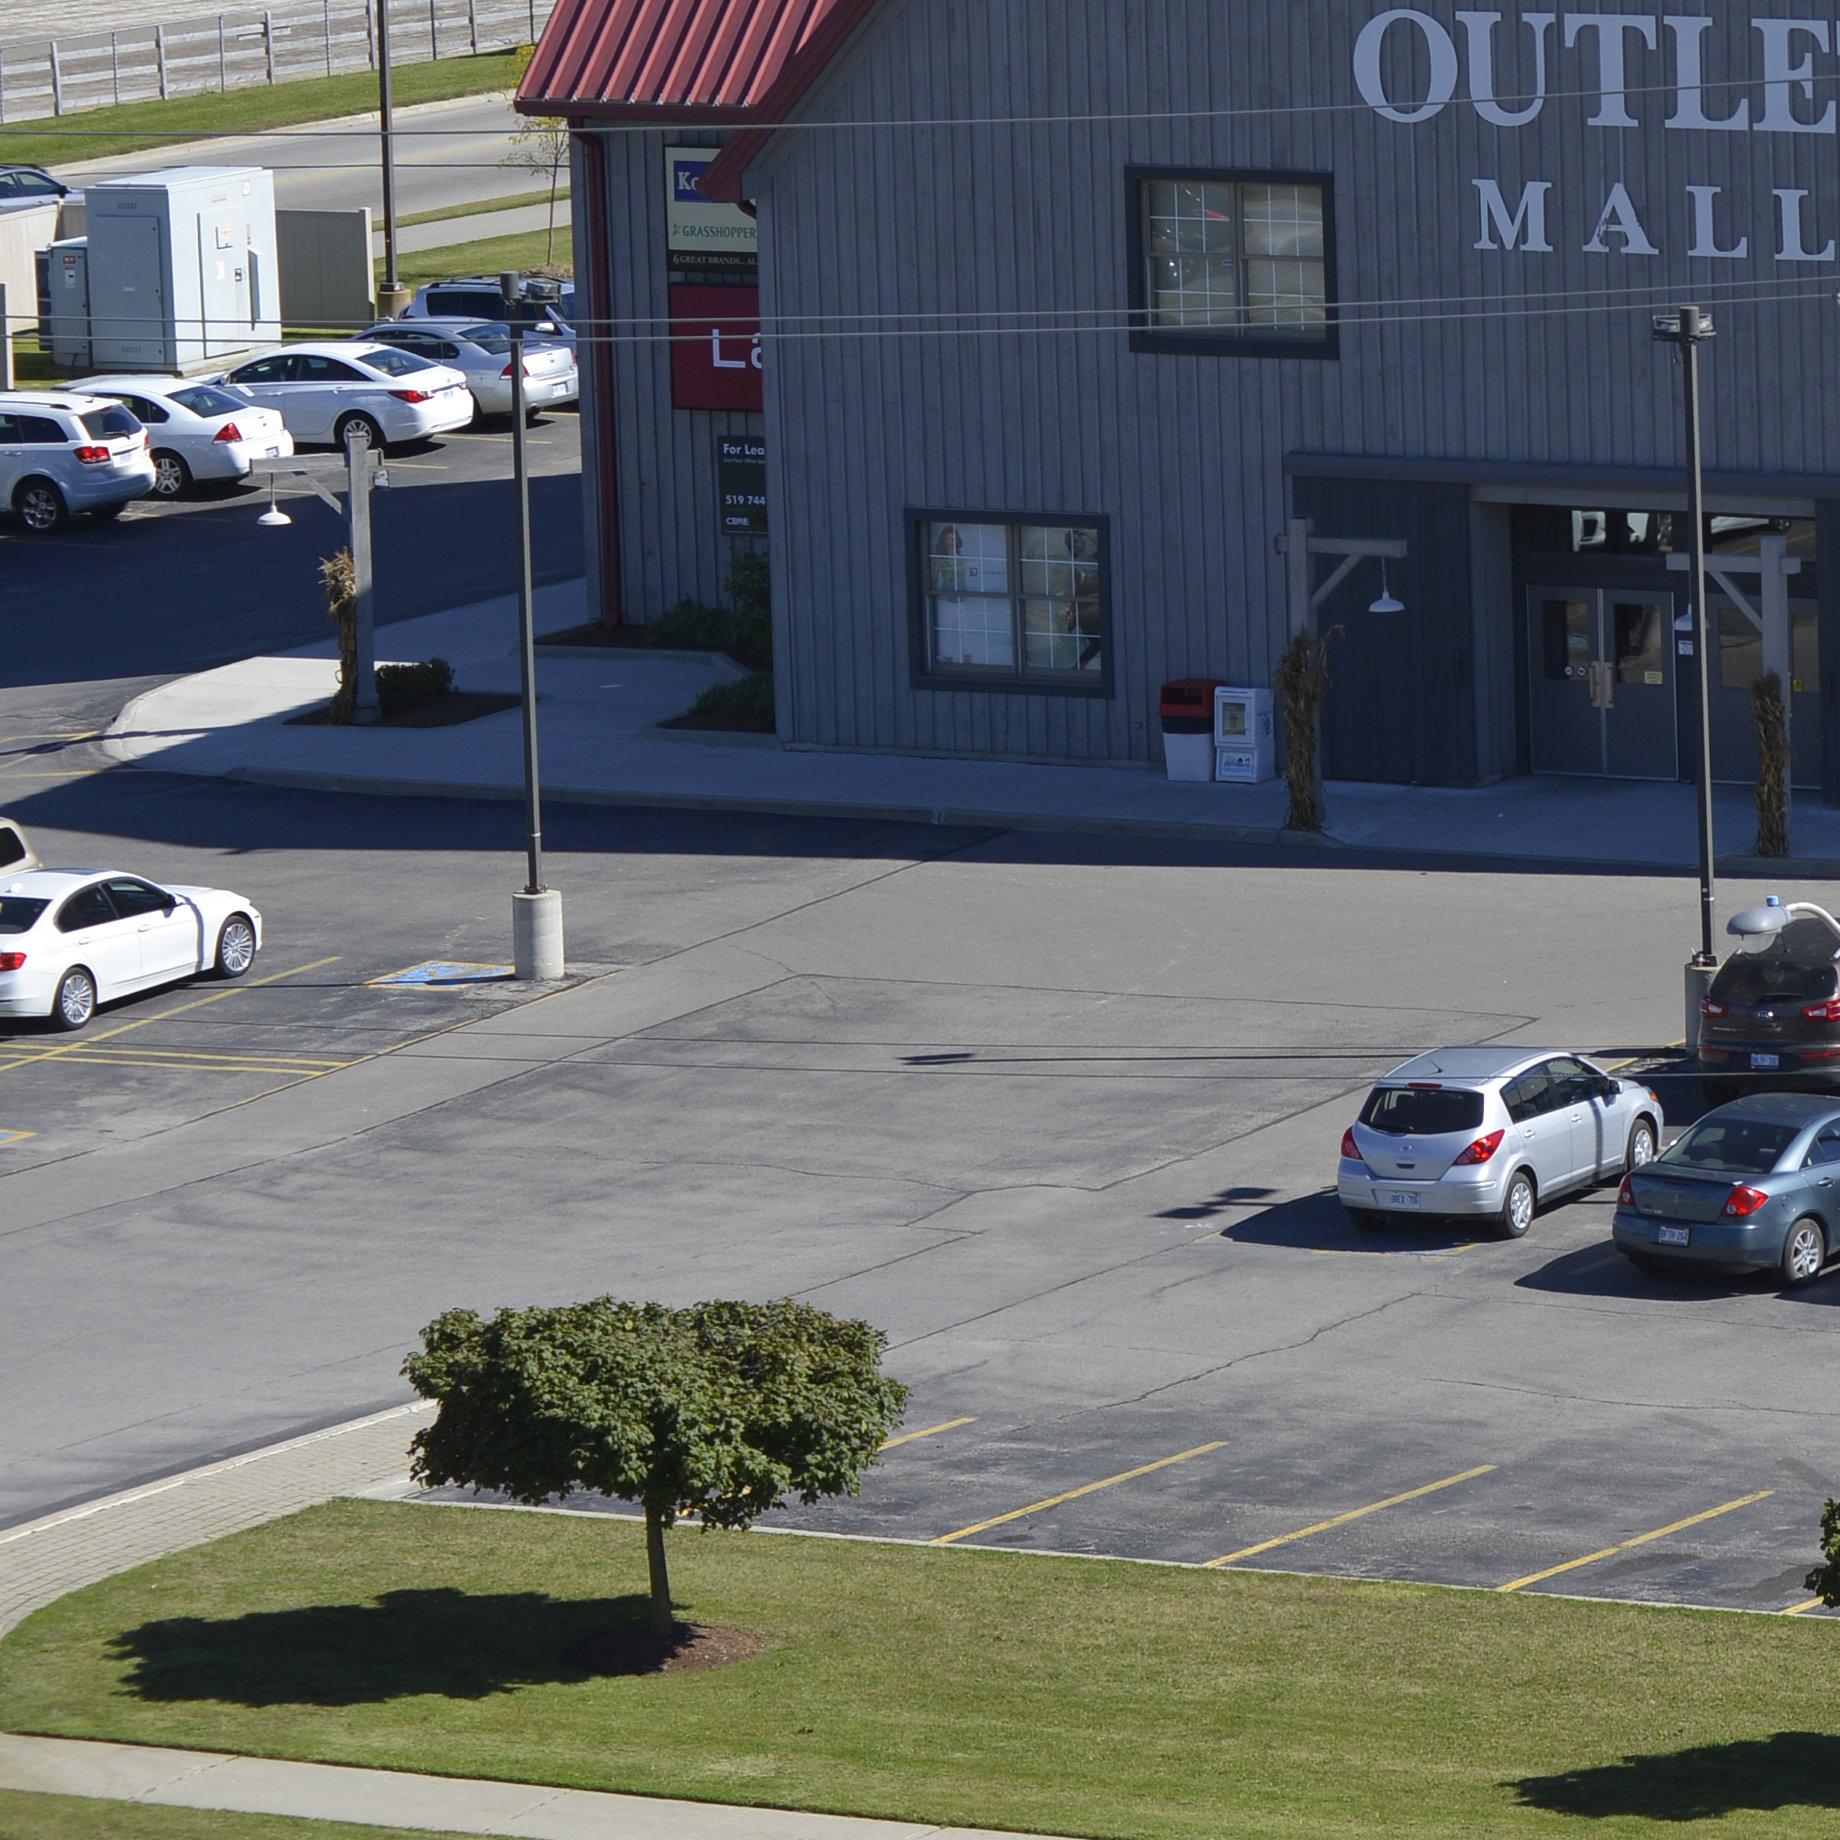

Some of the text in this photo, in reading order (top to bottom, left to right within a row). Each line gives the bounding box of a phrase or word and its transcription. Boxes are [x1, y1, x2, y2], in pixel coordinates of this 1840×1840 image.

[1472, 178, 1836, 262] MALL
[680, 255, 706, 264] GREAT
[724, 444, 764, 455] For Lea
[725, 495, 744, 505] 519
[725, 516, 749, 526] CBRE
